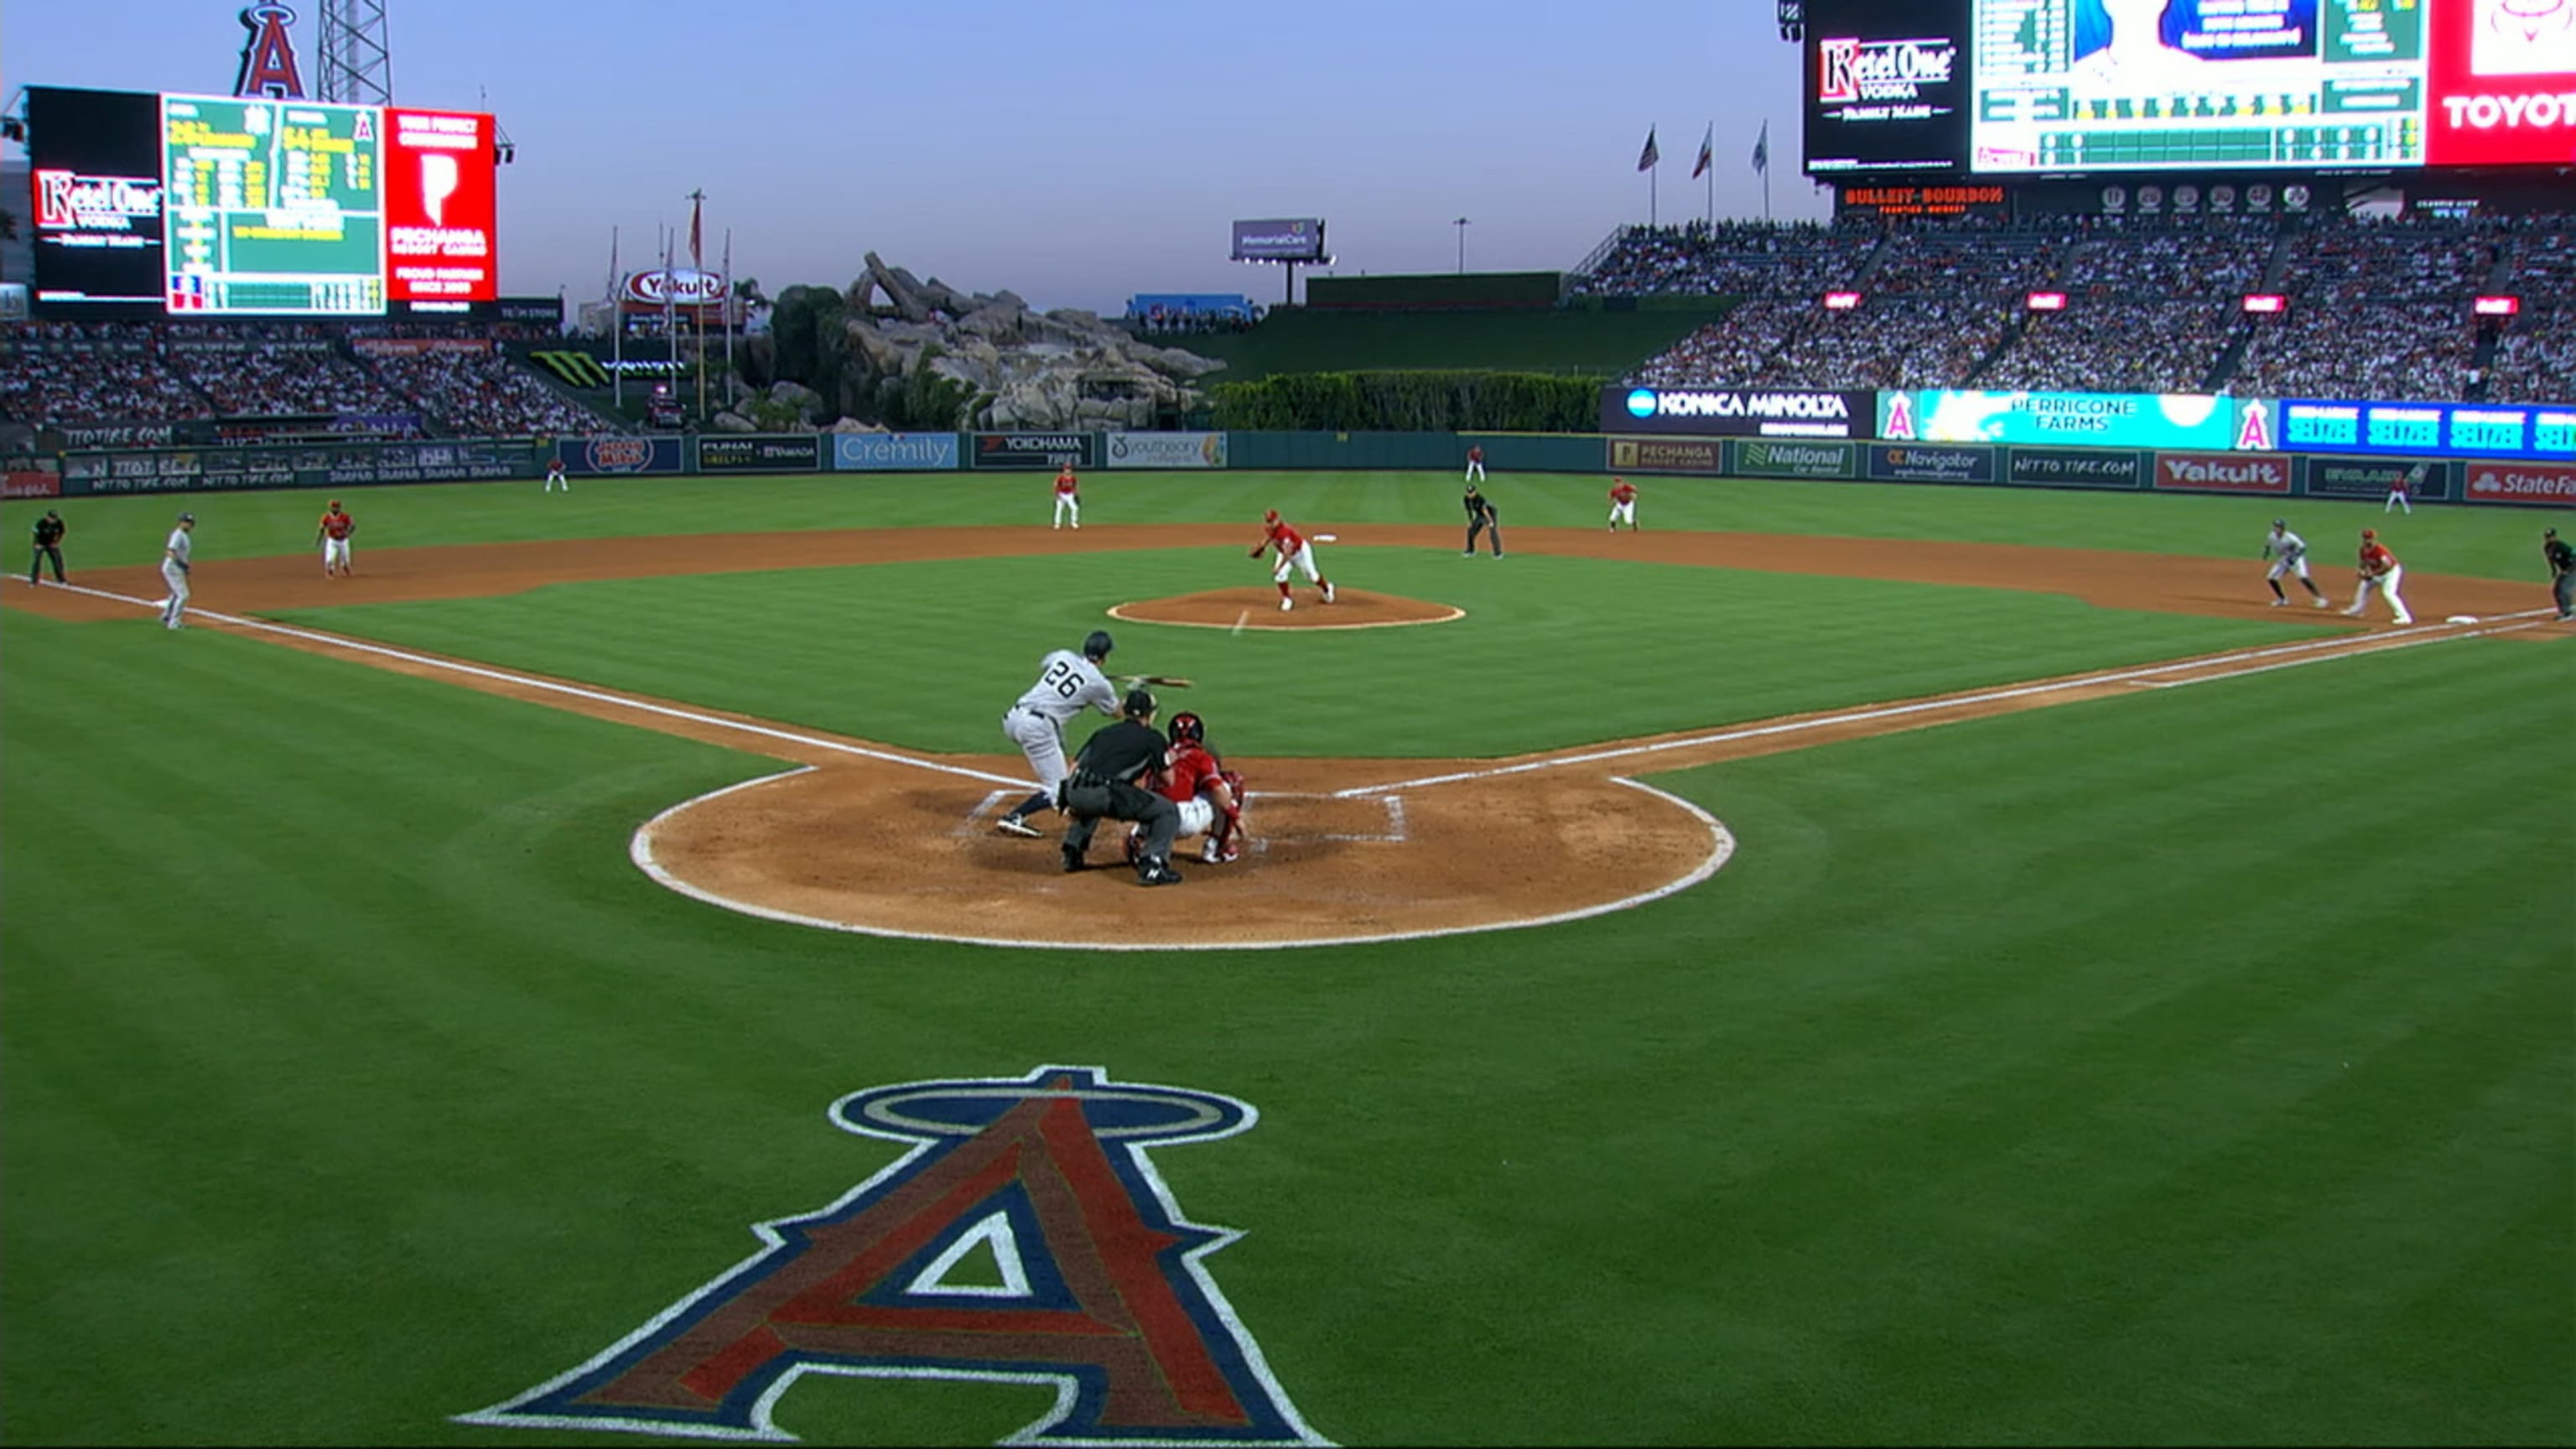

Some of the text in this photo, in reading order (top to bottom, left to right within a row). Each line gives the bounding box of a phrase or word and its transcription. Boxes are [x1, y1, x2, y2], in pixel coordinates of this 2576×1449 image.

[1859, 83, 1919, 100] VODKA
[1921, 186, 2004, 203] BOURBON
[1658, 392, 1849, 418] KONICA MINOLTA
[2012, 397, 2136, 415] PERRICONE
[2036, 416, 2108, 431] FARMS
[1006, 436, 1082, 450] YOKOHAMA
[1642, 444, 1712, 458] PECHANGA
[1768, 444, 1845, 465] National
[1905, 449, 1979, 470] Navigator
[2013, 456, 2060, 473] NITTO
[2164, 459, 2283, 485] Yakult
[1045, 661, 1085, 699] 26
